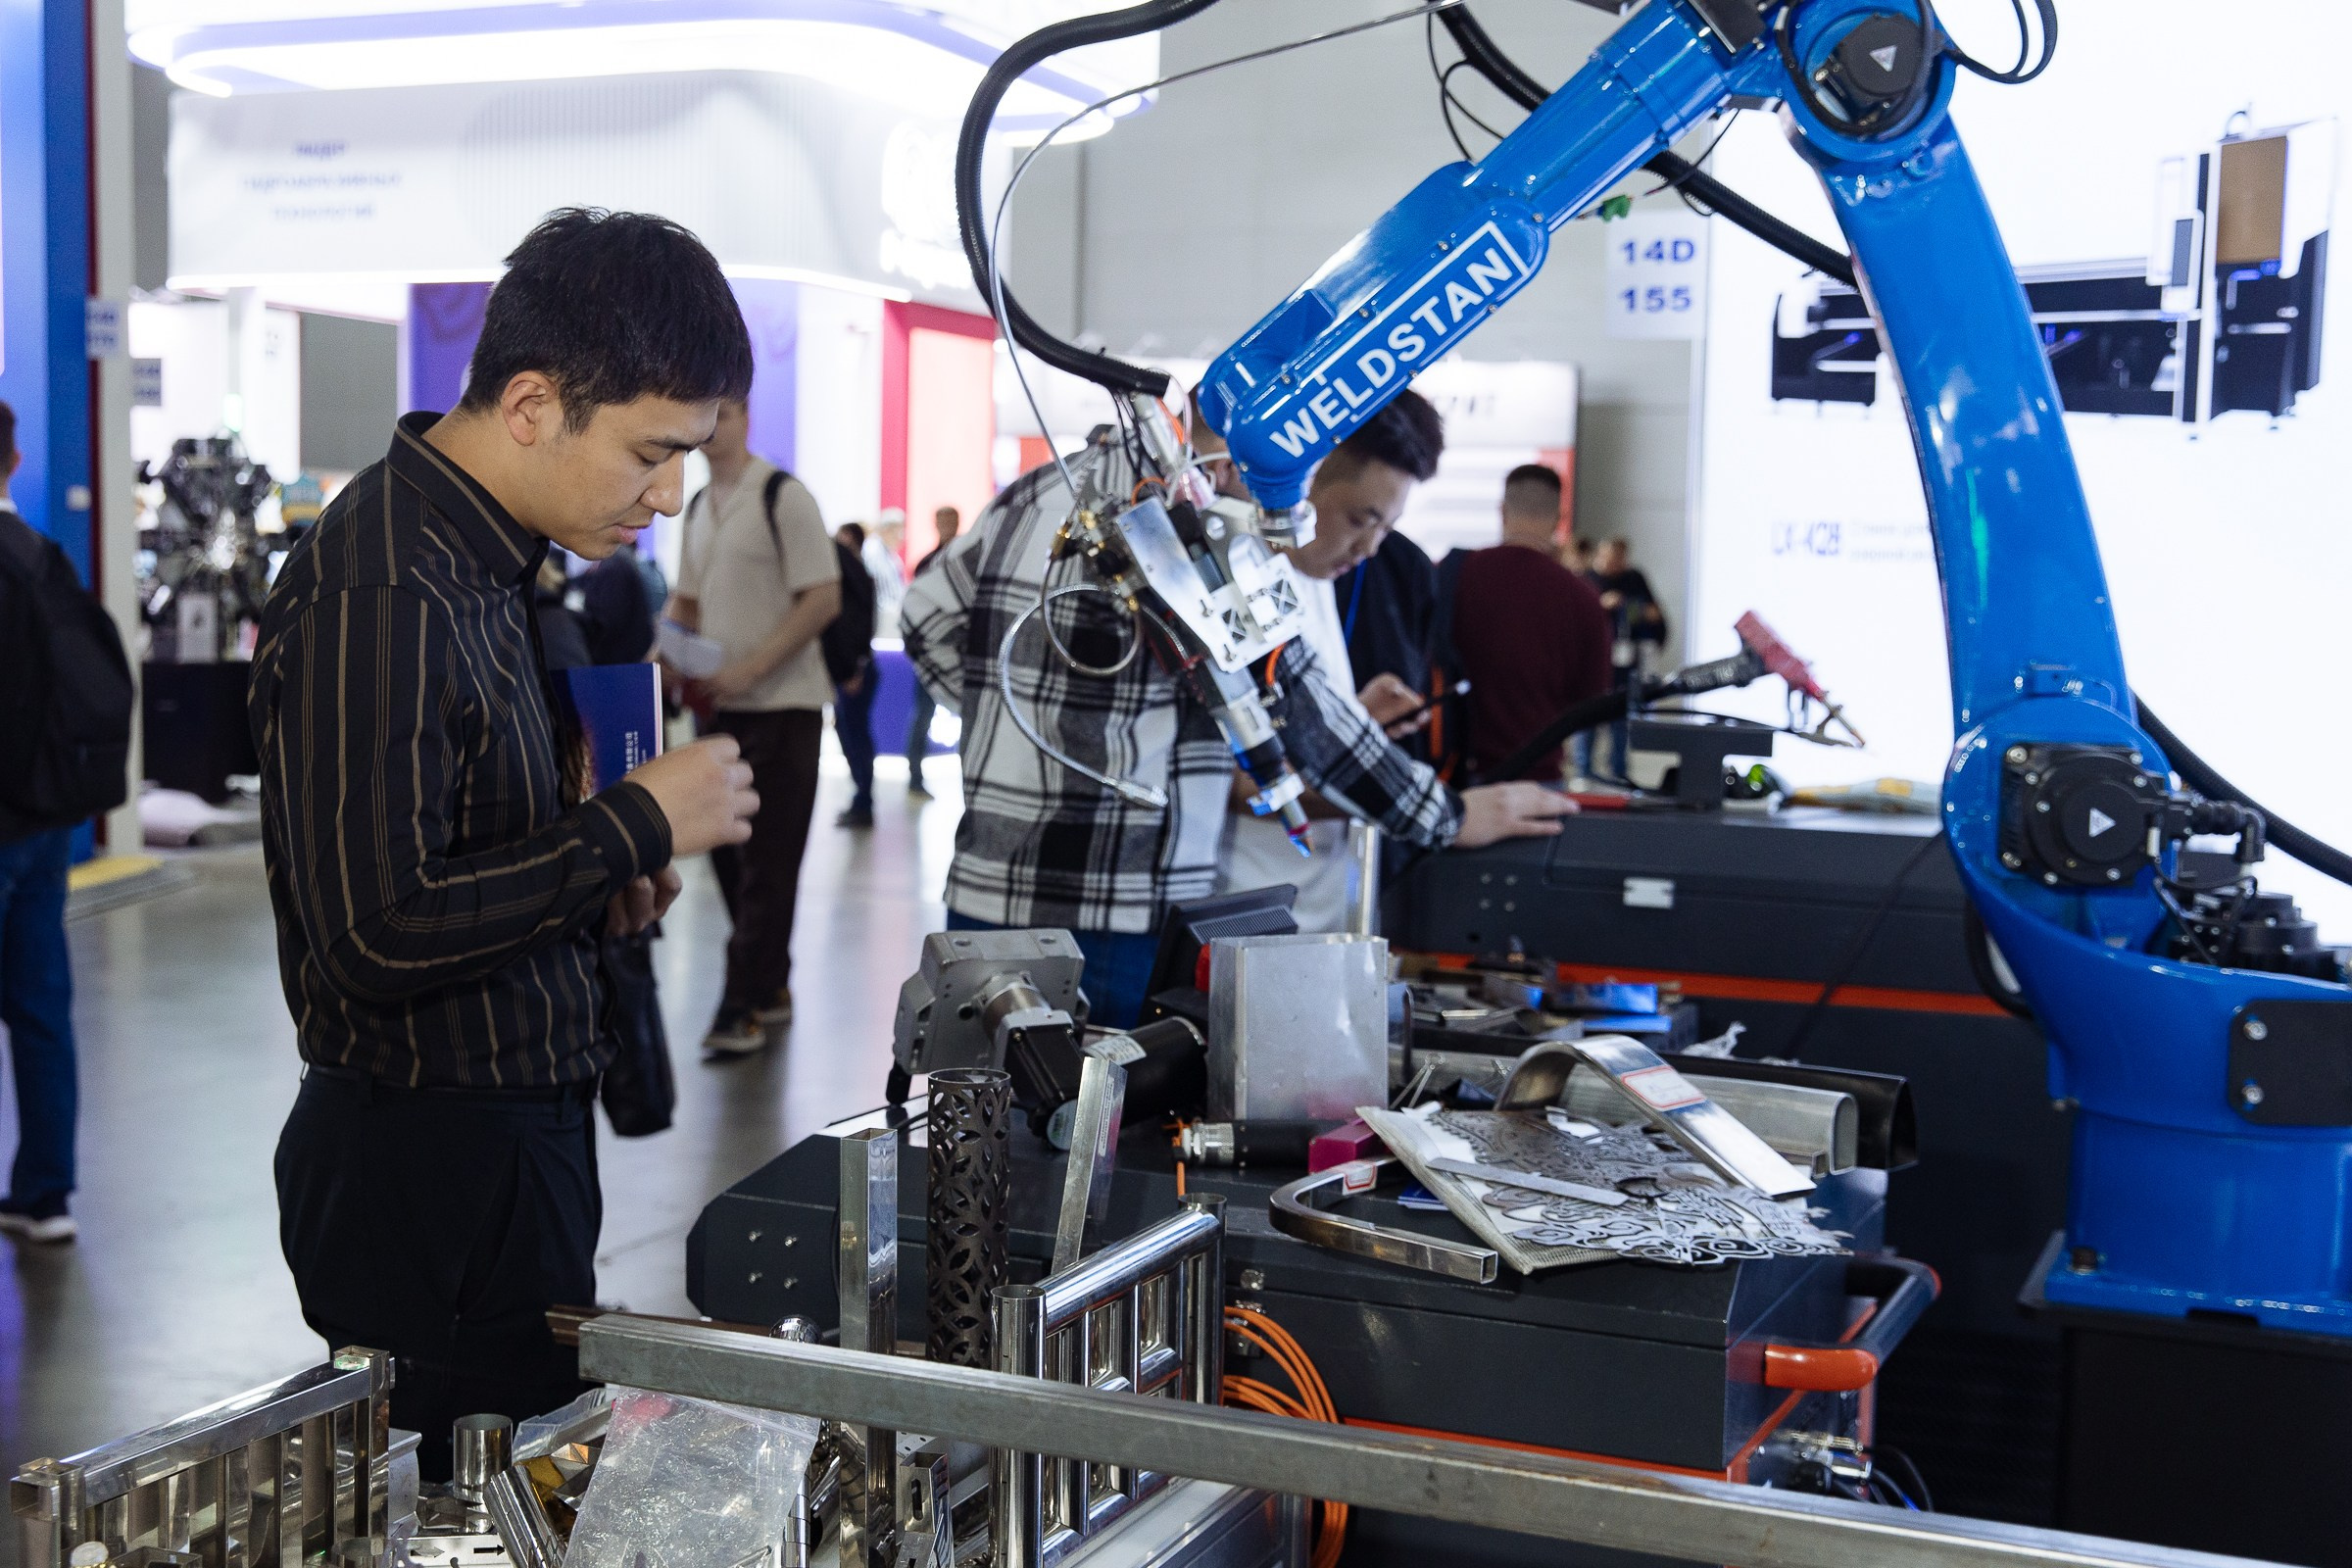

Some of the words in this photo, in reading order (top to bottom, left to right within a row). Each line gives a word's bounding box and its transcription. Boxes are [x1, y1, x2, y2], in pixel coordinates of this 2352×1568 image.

[1622, 239, 1695, 264] 14D
[1621, 286, 1692, 313] 155
[1269, 247, 1513, 459] WELDSTAN
